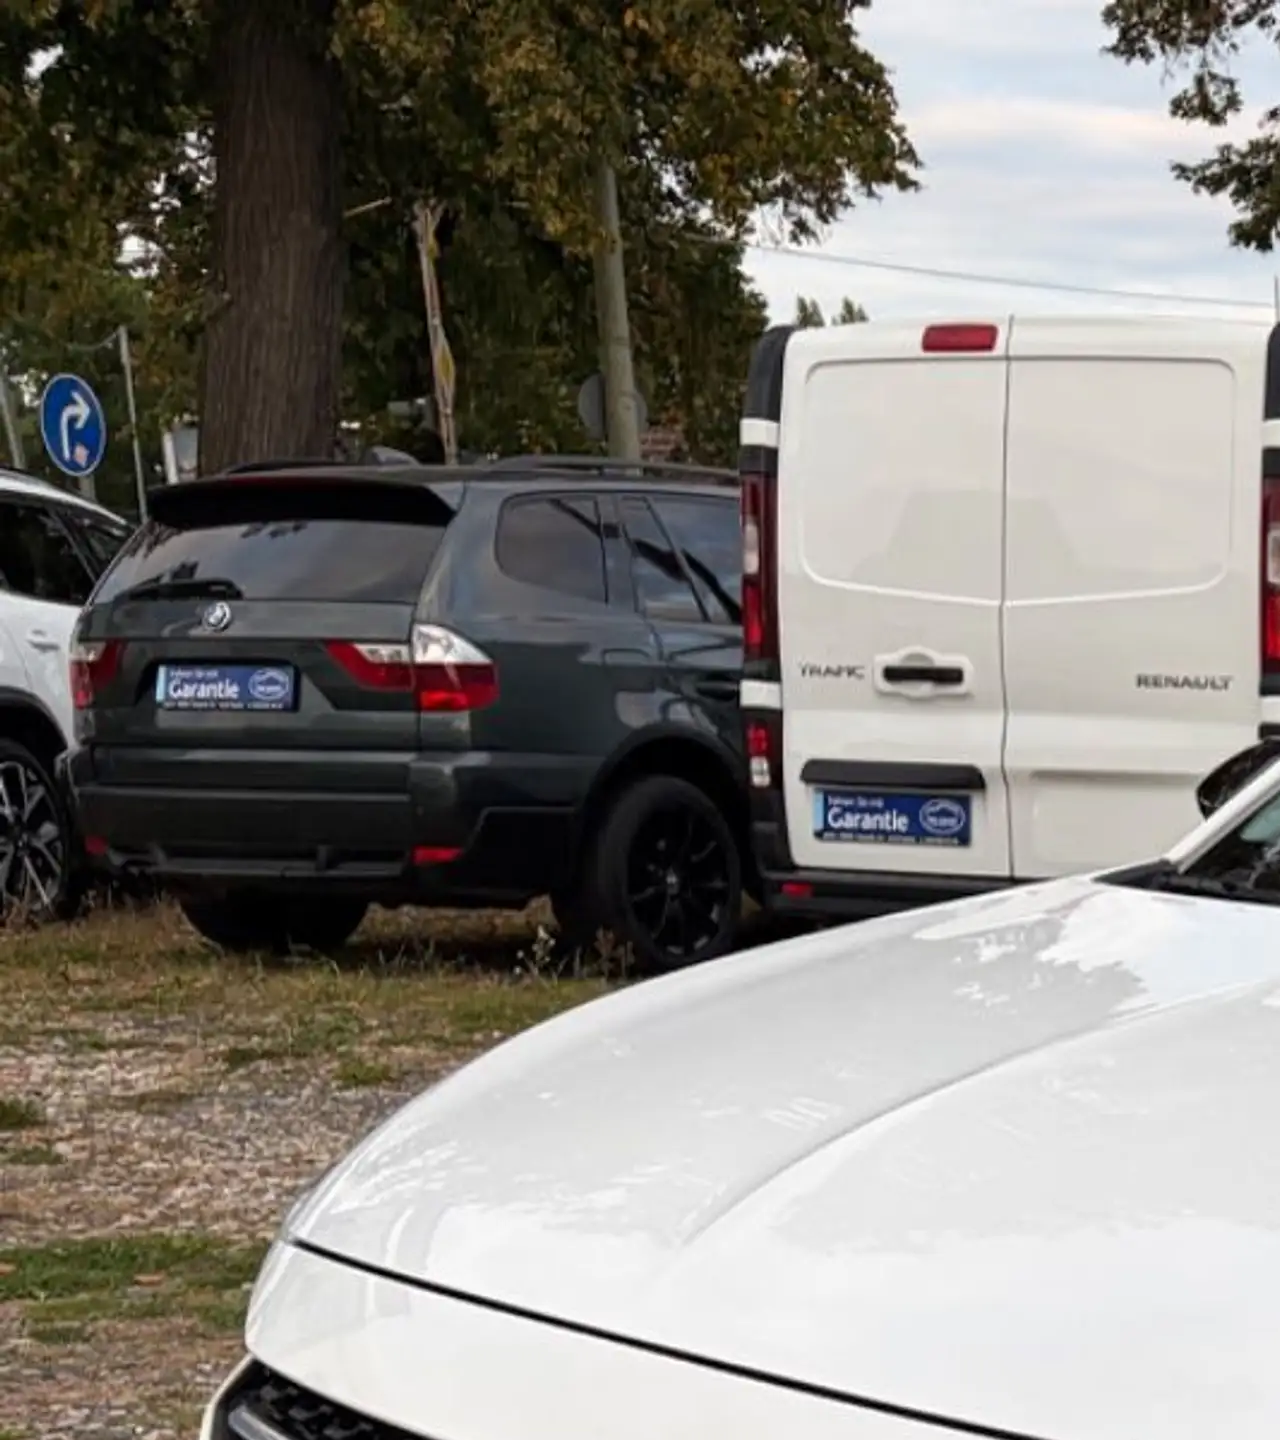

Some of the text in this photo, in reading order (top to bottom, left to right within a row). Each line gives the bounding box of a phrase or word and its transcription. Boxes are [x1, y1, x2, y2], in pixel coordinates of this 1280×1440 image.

[168, 677, 241, 700] Garantie
[1136, 674, 1234, 692] RENAULT
[827, 805, 910, 834] Garantie
